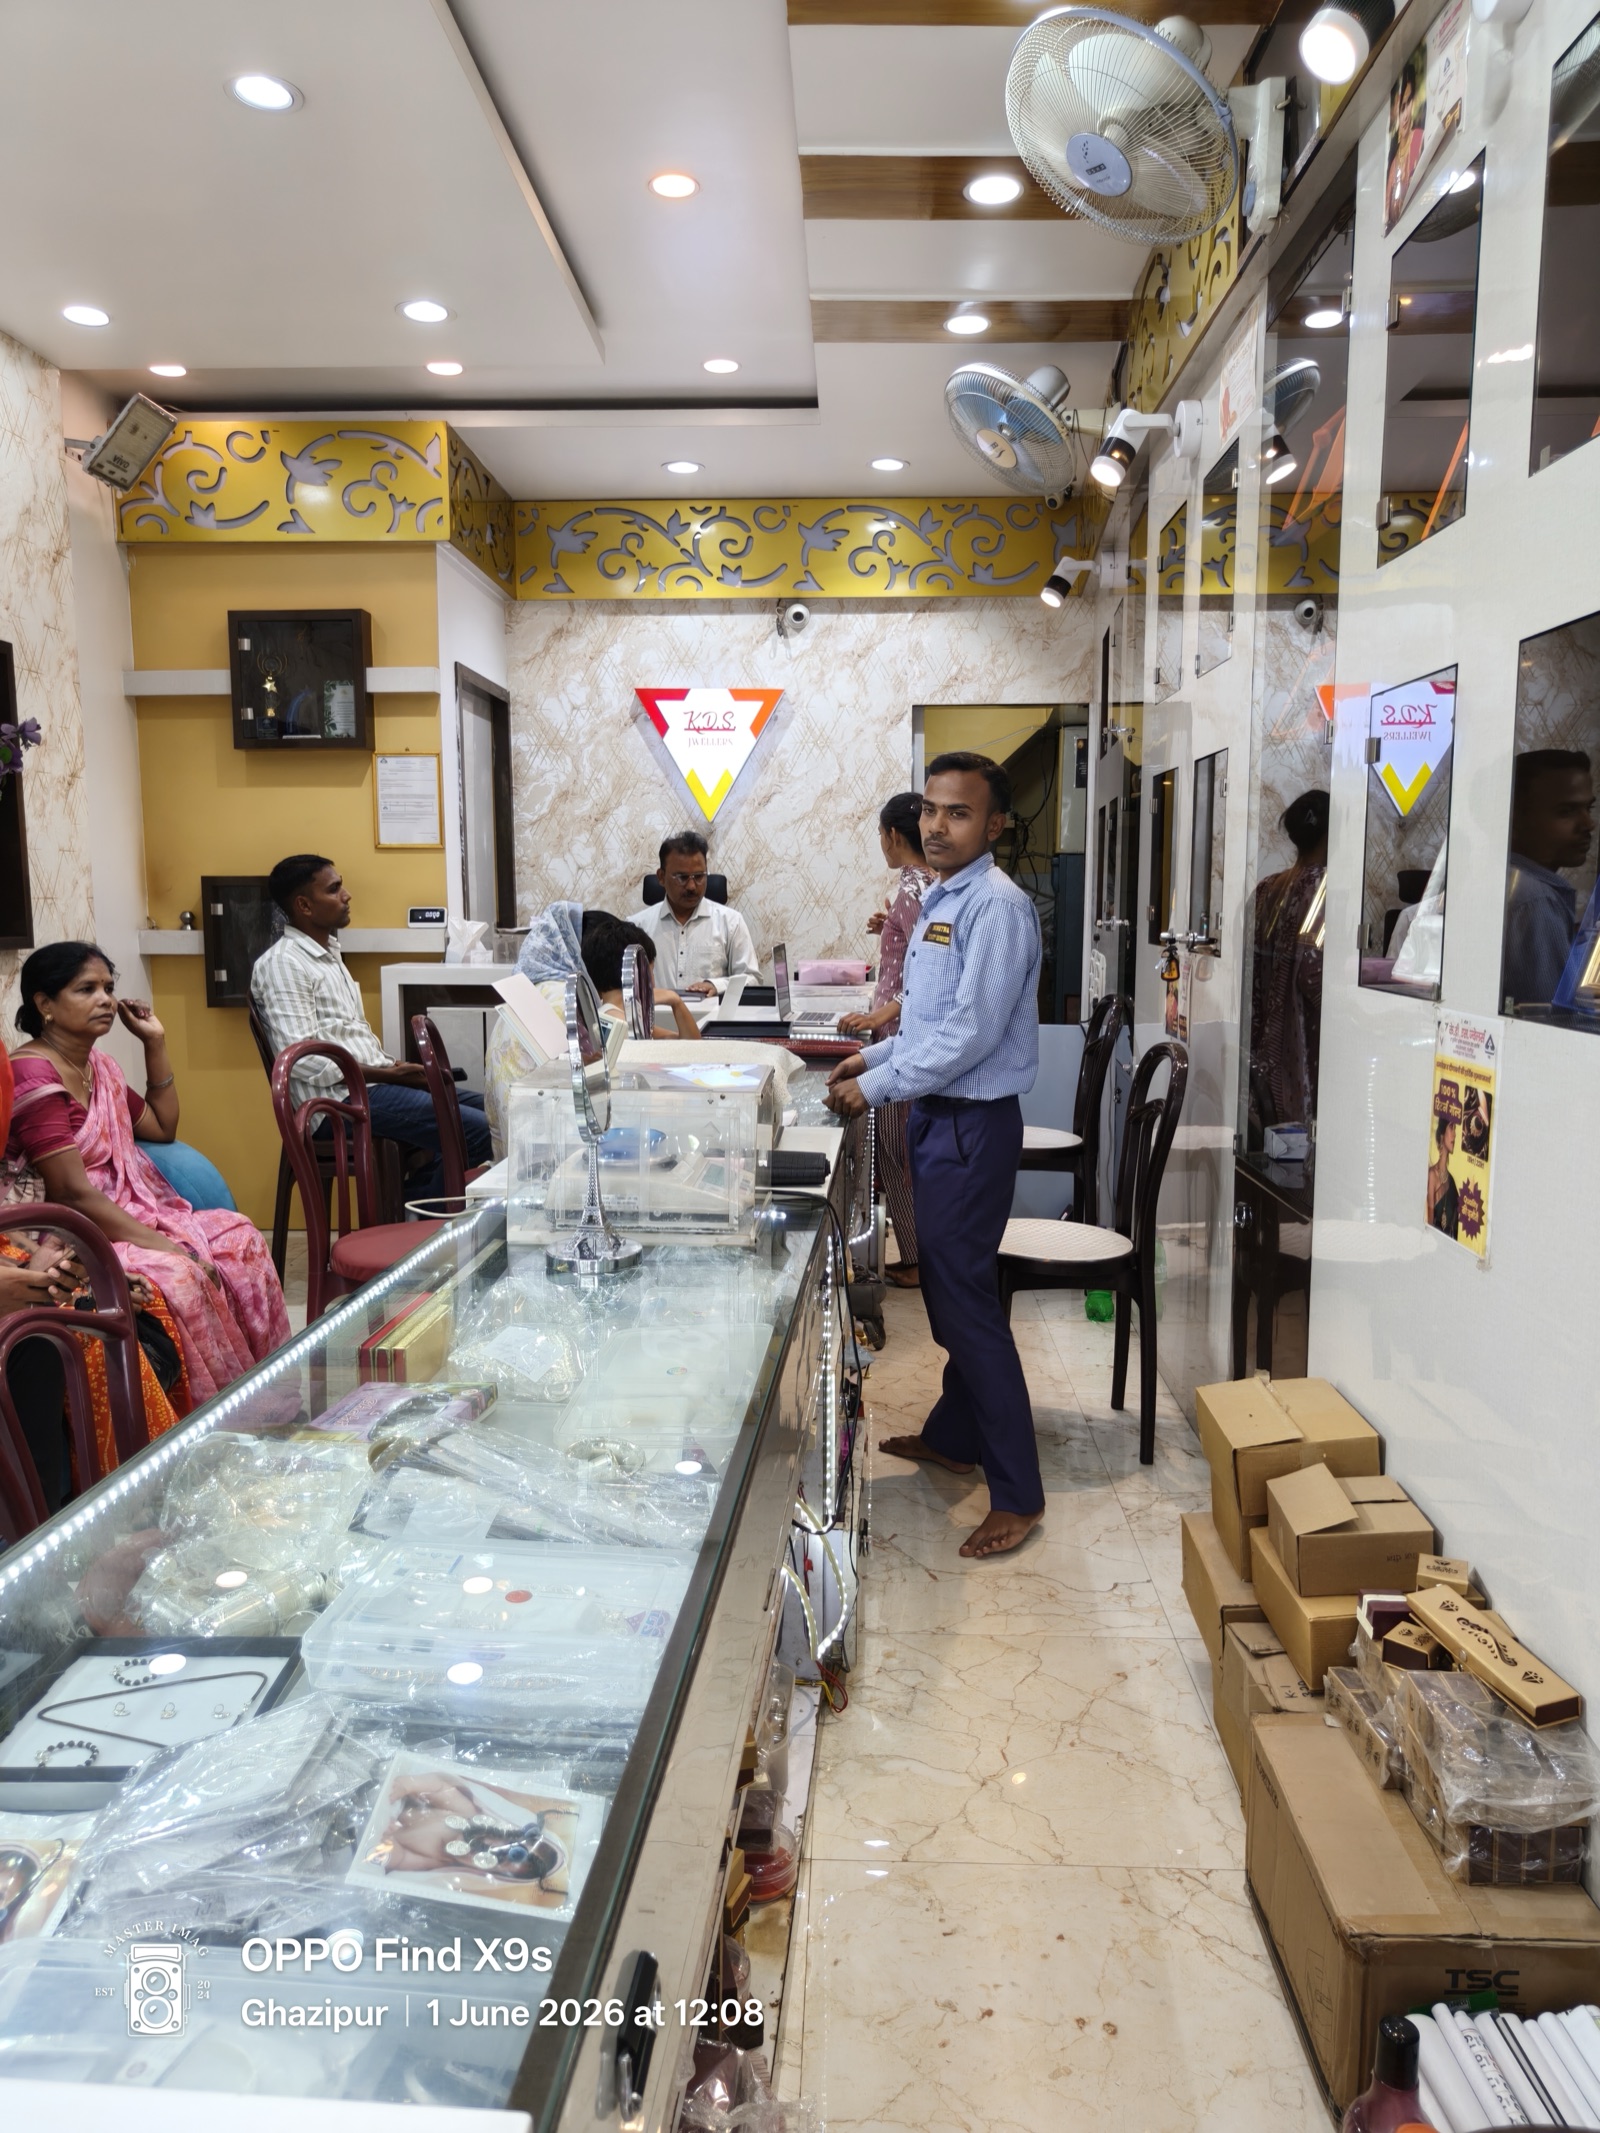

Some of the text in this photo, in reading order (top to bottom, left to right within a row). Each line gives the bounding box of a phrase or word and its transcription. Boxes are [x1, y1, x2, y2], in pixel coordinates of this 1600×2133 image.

[683, 711, 736, 734] K.D.S.
[688, 737, 733, 747] JWELLERS
[1445, 1969, 1520, 1990] TSC
